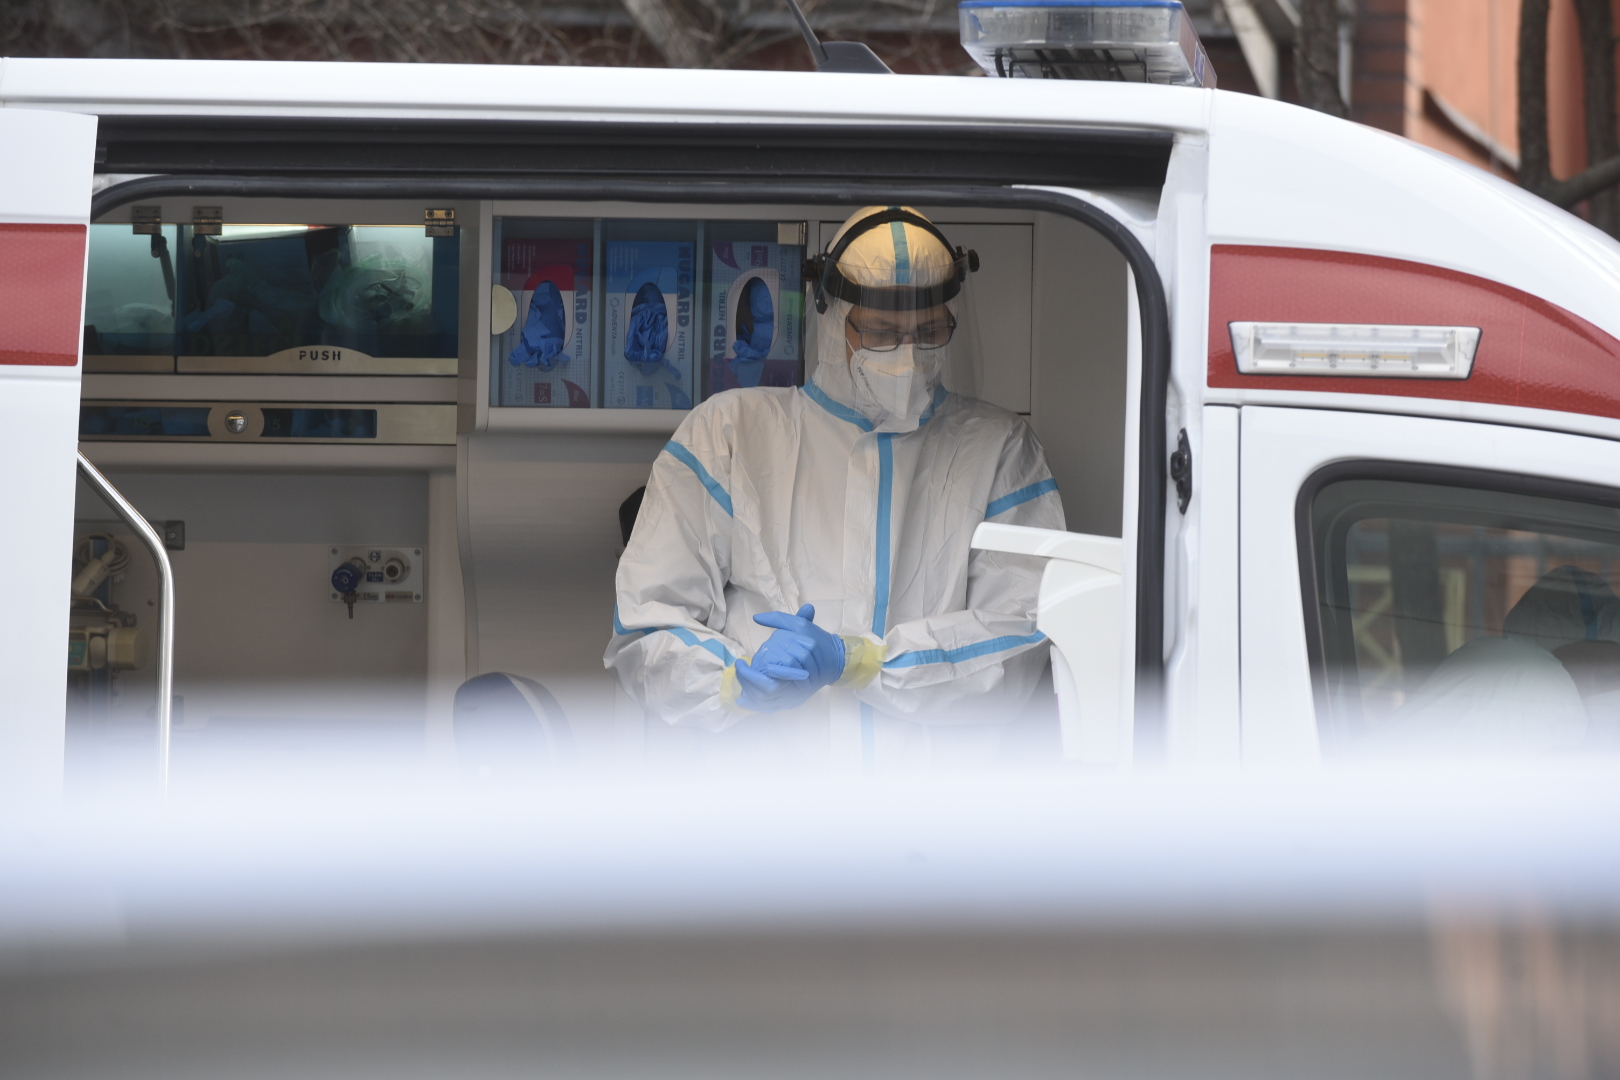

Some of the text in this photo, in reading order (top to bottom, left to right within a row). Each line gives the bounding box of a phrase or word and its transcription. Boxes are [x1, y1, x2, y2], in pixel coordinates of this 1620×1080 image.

[575, 243, 589, 360] NUGARD NITRIL
[677, 246, 691, 363] NUGARD NITRIL
[713, 289, 727, 394] UGARD NITRIL
[299, 350, 341, 361] PUSH
[538, 383, 547, 403] 7=S
